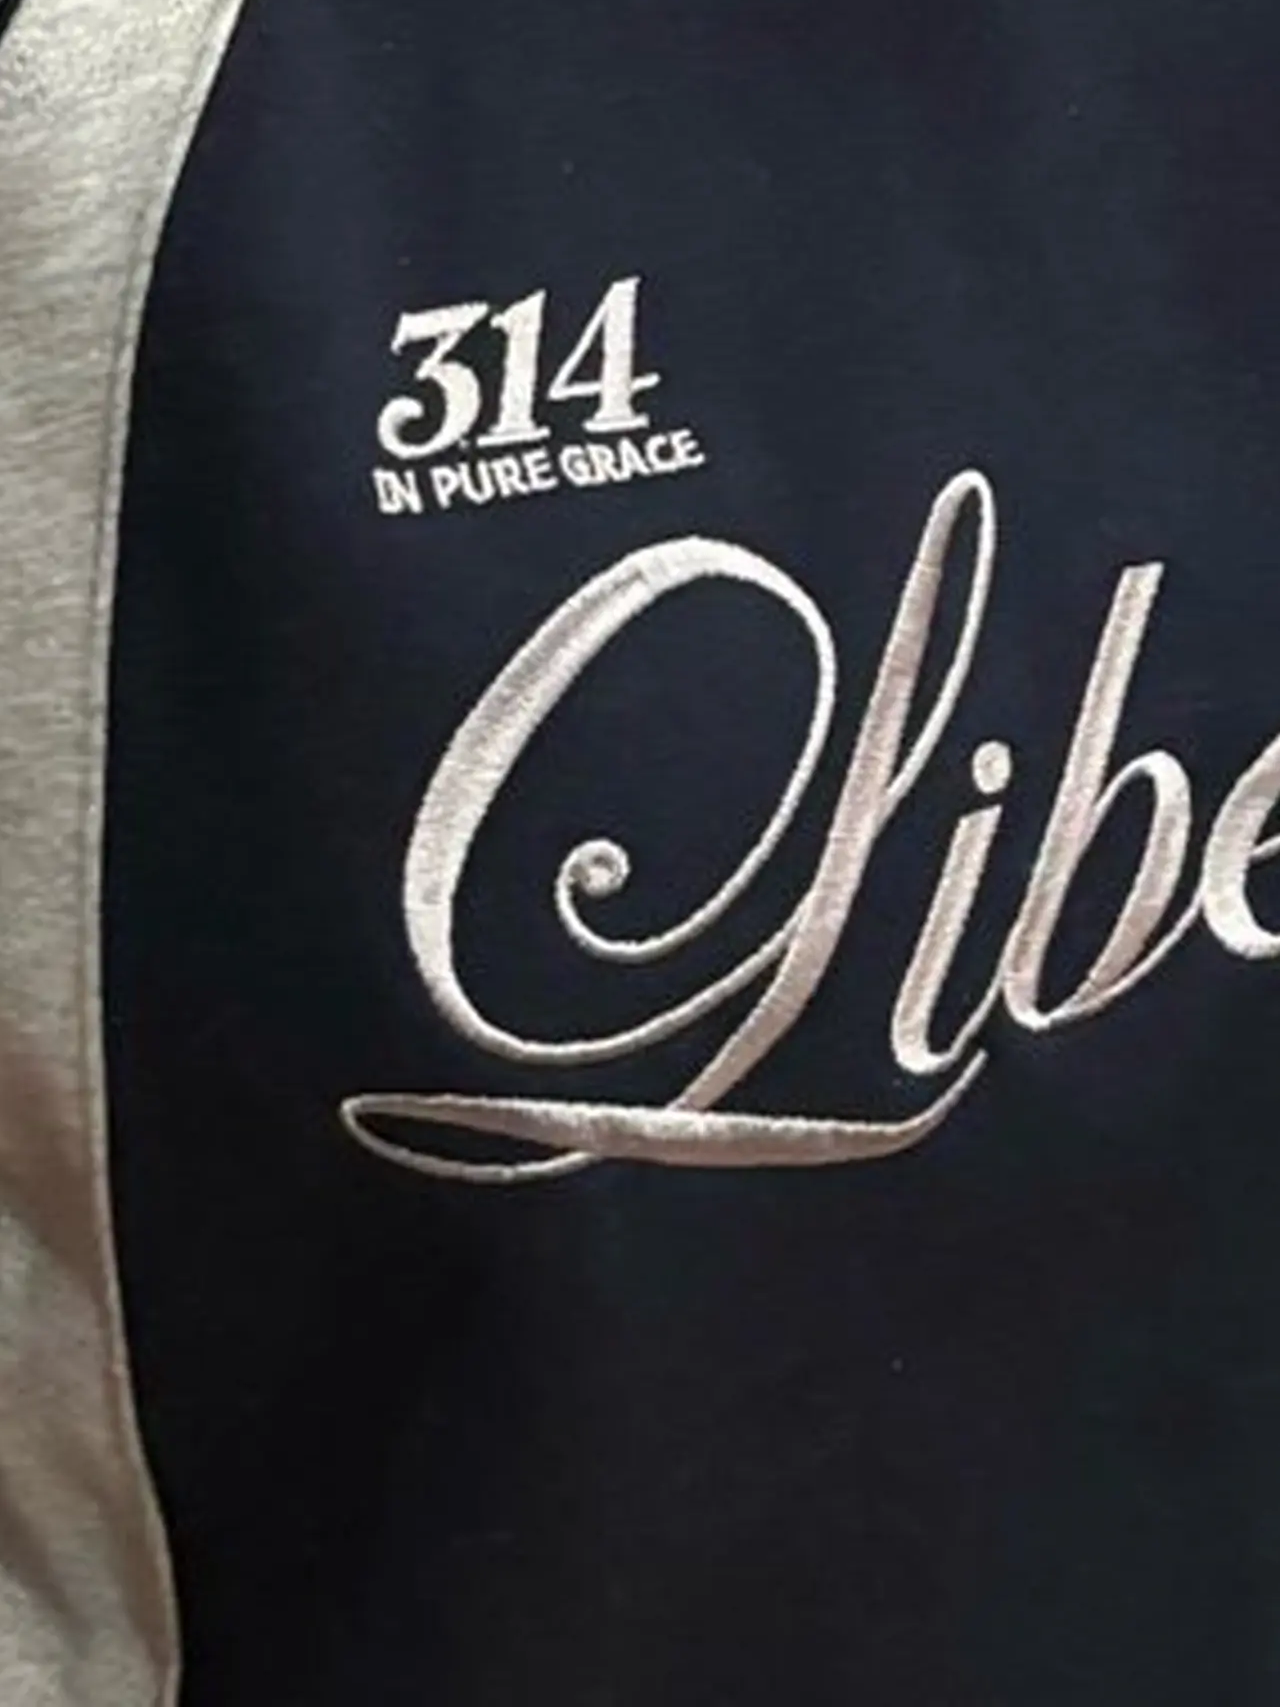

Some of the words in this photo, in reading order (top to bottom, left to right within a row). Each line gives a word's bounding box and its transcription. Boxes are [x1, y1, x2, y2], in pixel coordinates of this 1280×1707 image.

[376, 275, 662, 461] 314
[372, 466, 424, 515] IN
[429, 445, 559, 510] PURE
[558, 428, 707, 488] GRACE
